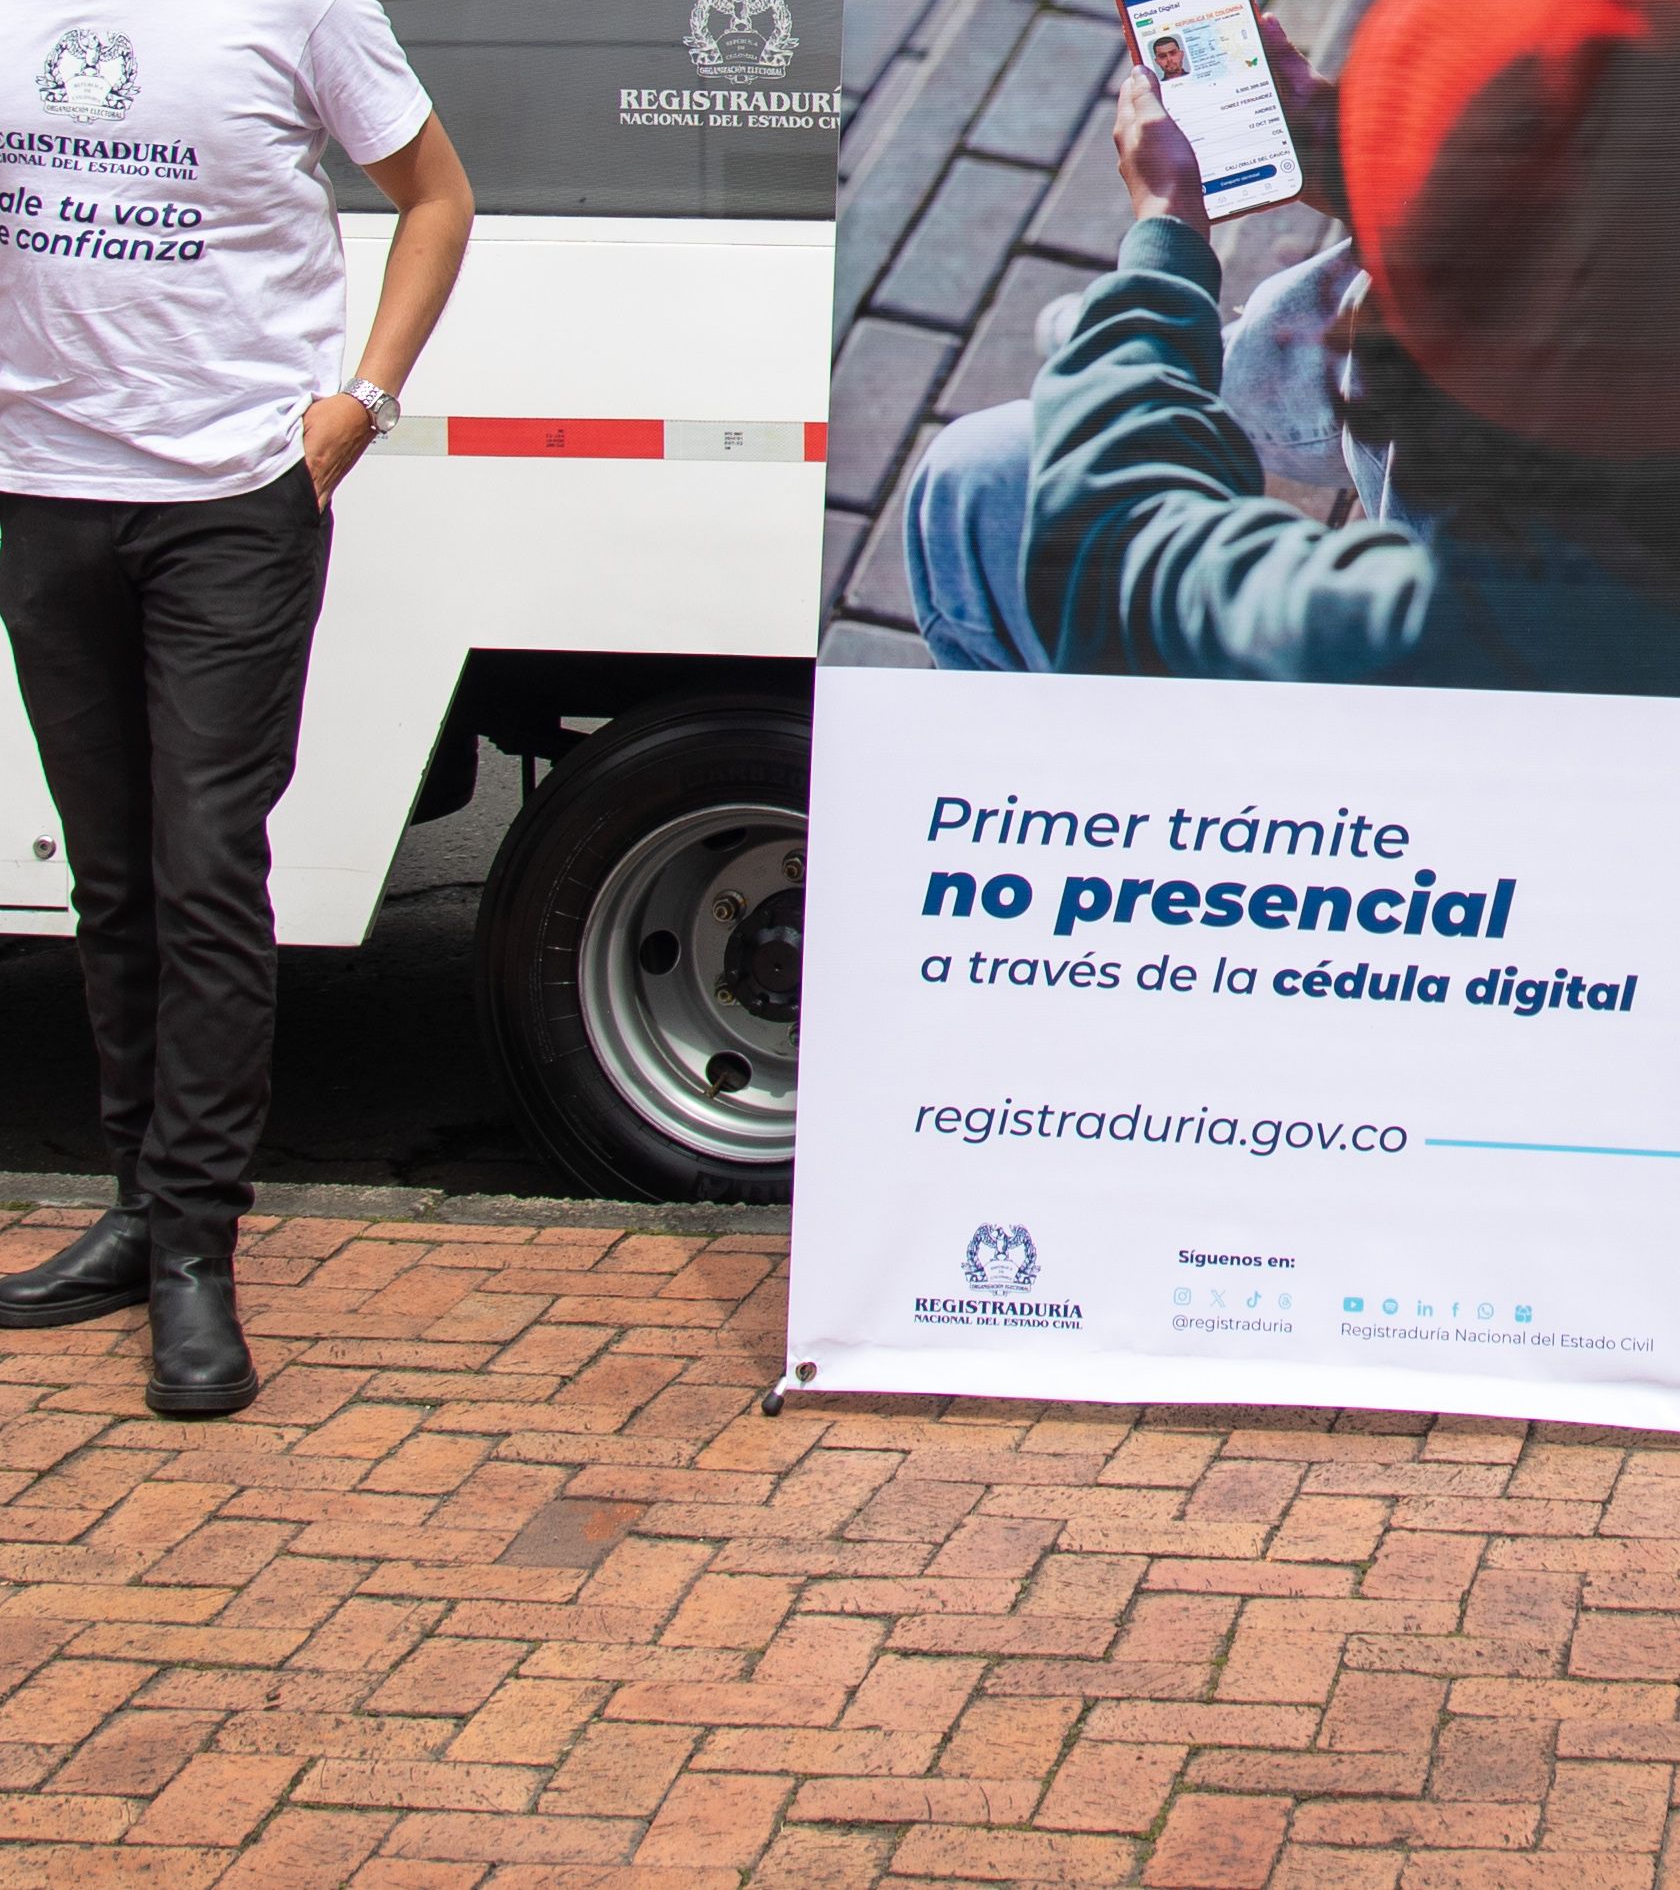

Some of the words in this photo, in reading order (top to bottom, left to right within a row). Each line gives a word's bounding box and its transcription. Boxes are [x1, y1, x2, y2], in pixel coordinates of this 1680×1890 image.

[620, 86, 841, 113] REGISTRADURÍ
[620, 113, 704, 126] NACIONAL
[709, 114, 745, 127] DEL
[748, 115, 814, 128] ESTADO
[52, 157, 82, 171] DEL
[88, 161, 150, 177] ESTADO
[155, 167, 198, 181] CIVIL
[59, 196, 98, 223] tu
[115, 203, 202, 228] voto
[16, 229, 205, 261] confianza
[927, 794, 1151, 851] Primer
[1168, 805, 1410, 860] trámite
[921, 870, 1033, 920] no
[1053, 868, 1517, 940] presencial
[920, 954, 951, 984] a
[968, 950, 1121, 991] través
[1136, 954, 1198, 994] de
[1213, 958, 1258, 996] la
[1271, 960, 1447, 1005] cédula
[1465, 966, 1638, 1016] digital
[914, 1098, 1408, 1157] registraduria.gov.co
[1178, 1250, 1263, 1269] Síguenos
[1267, 1254, 1296, 1269] en:
[914, 1297, 1083, 1318] REGISTRADURÍA
[914, 1314, 972, 1325] NACIONAL
[976, 1317, 1000, 1326] DEL
[1004, 1318, 1049, 1328] ESTADO
[1053, 1320, 1083, 1330] CIVIL
[1172, 1313, 1293, 1335] @registraduria
[1341, 1322, 1450, 1343] Registraduría
[1455, 1327, 1526, 1346] Nacional
[1531, 1330, 1556, 1347] del
[1560, 1333, 1616, 1351] Estado
[1620, 1336, 1654, 1352] Civil
